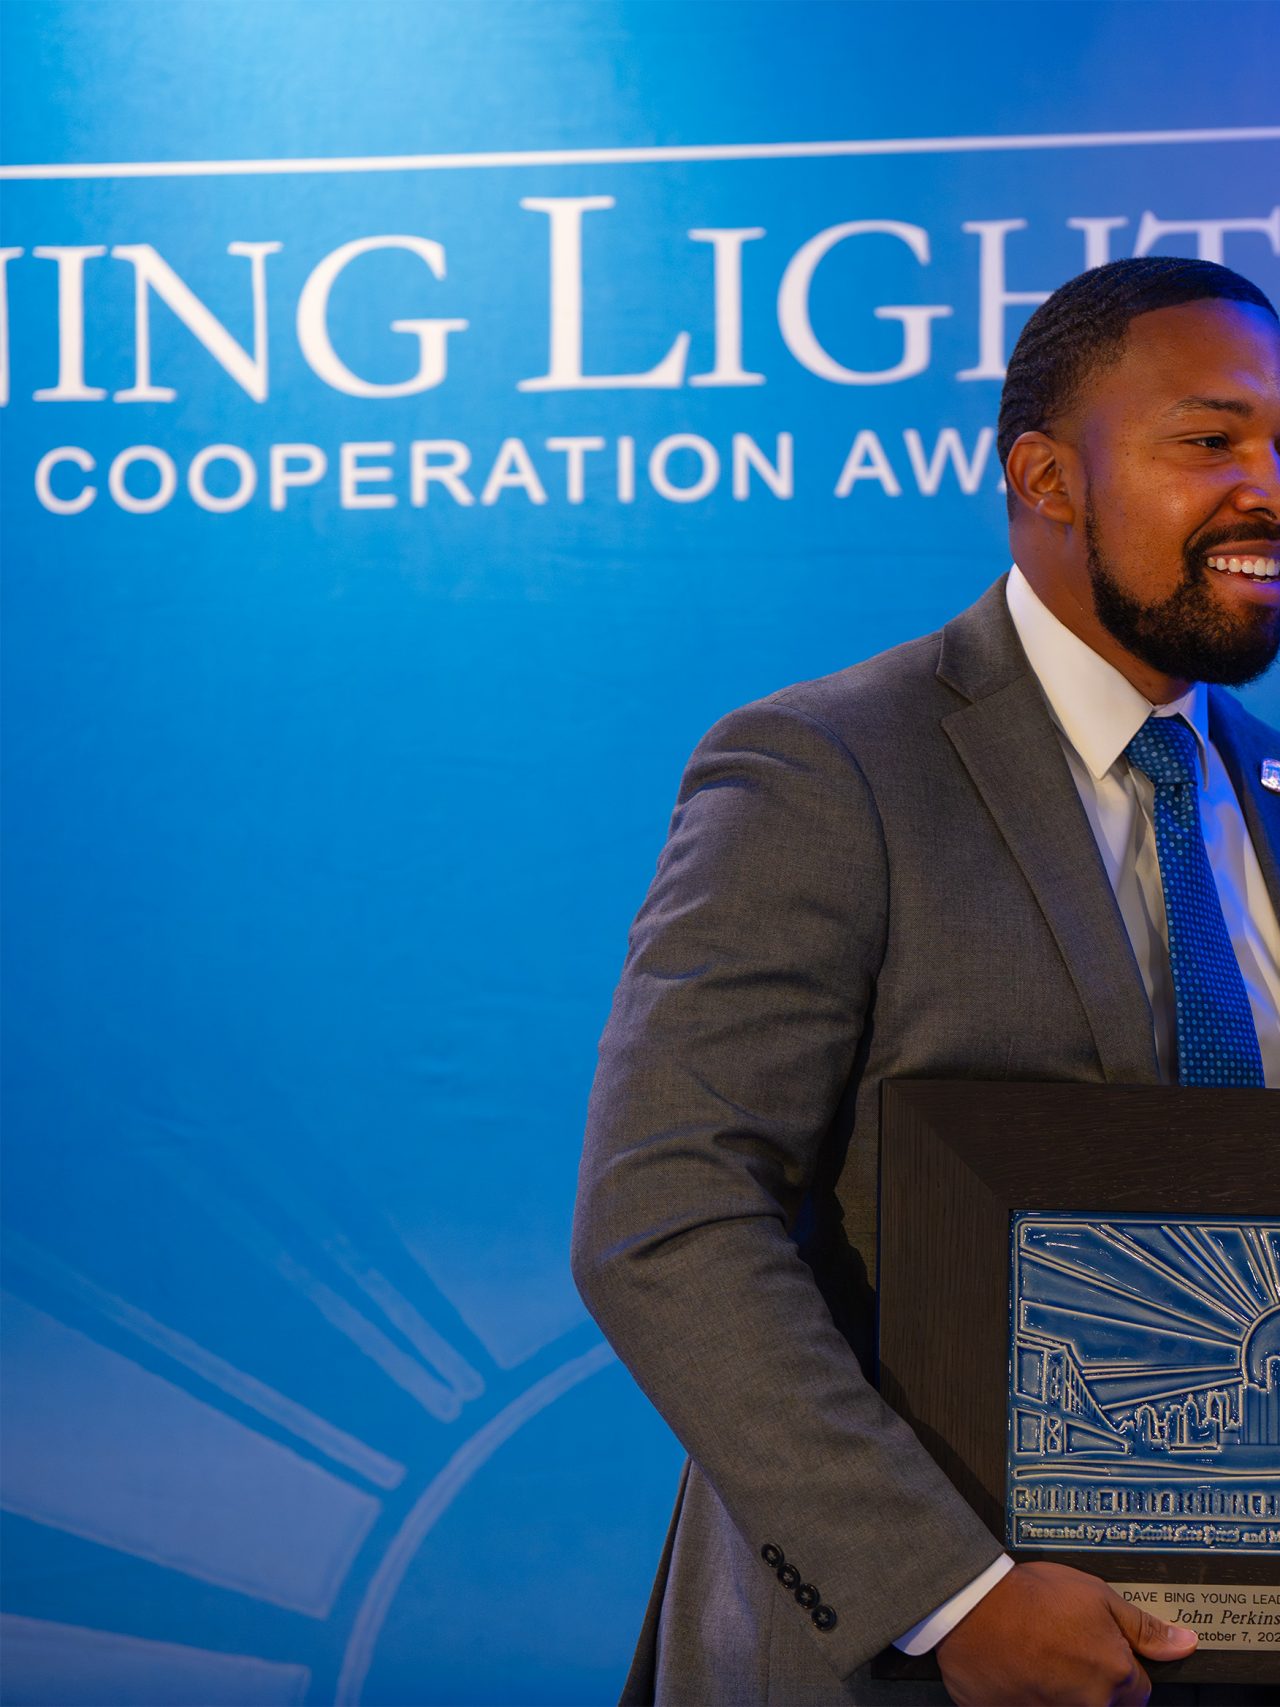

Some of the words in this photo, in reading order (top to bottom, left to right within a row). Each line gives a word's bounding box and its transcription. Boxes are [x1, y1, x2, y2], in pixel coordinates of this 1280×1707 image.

[0, 234, 470, 404] ING
[34, 431, 794, 515] COOPERATION
[834, 427, 1009, 498] AW
[1021, 1523, 1085, 1539] Presented
[1087, 1525, 1104, 1542] by
[1106, 1526, 1127, 1540] the
[1242, 1528, 1267, 1543] and
[1123, 1591, 1158, 1602] DAVE
[1164, 1592, 1195, 1603] BING
[1201, 1593, 1247, 1604] YOUNG
[1170, 1608, 1213, 1624] John
[1220, 1609, 1280, 1626] Perkins
[1194, 1630, 1236, 1642] ctober
[1241, 1631, 1251, 1643] 7,
